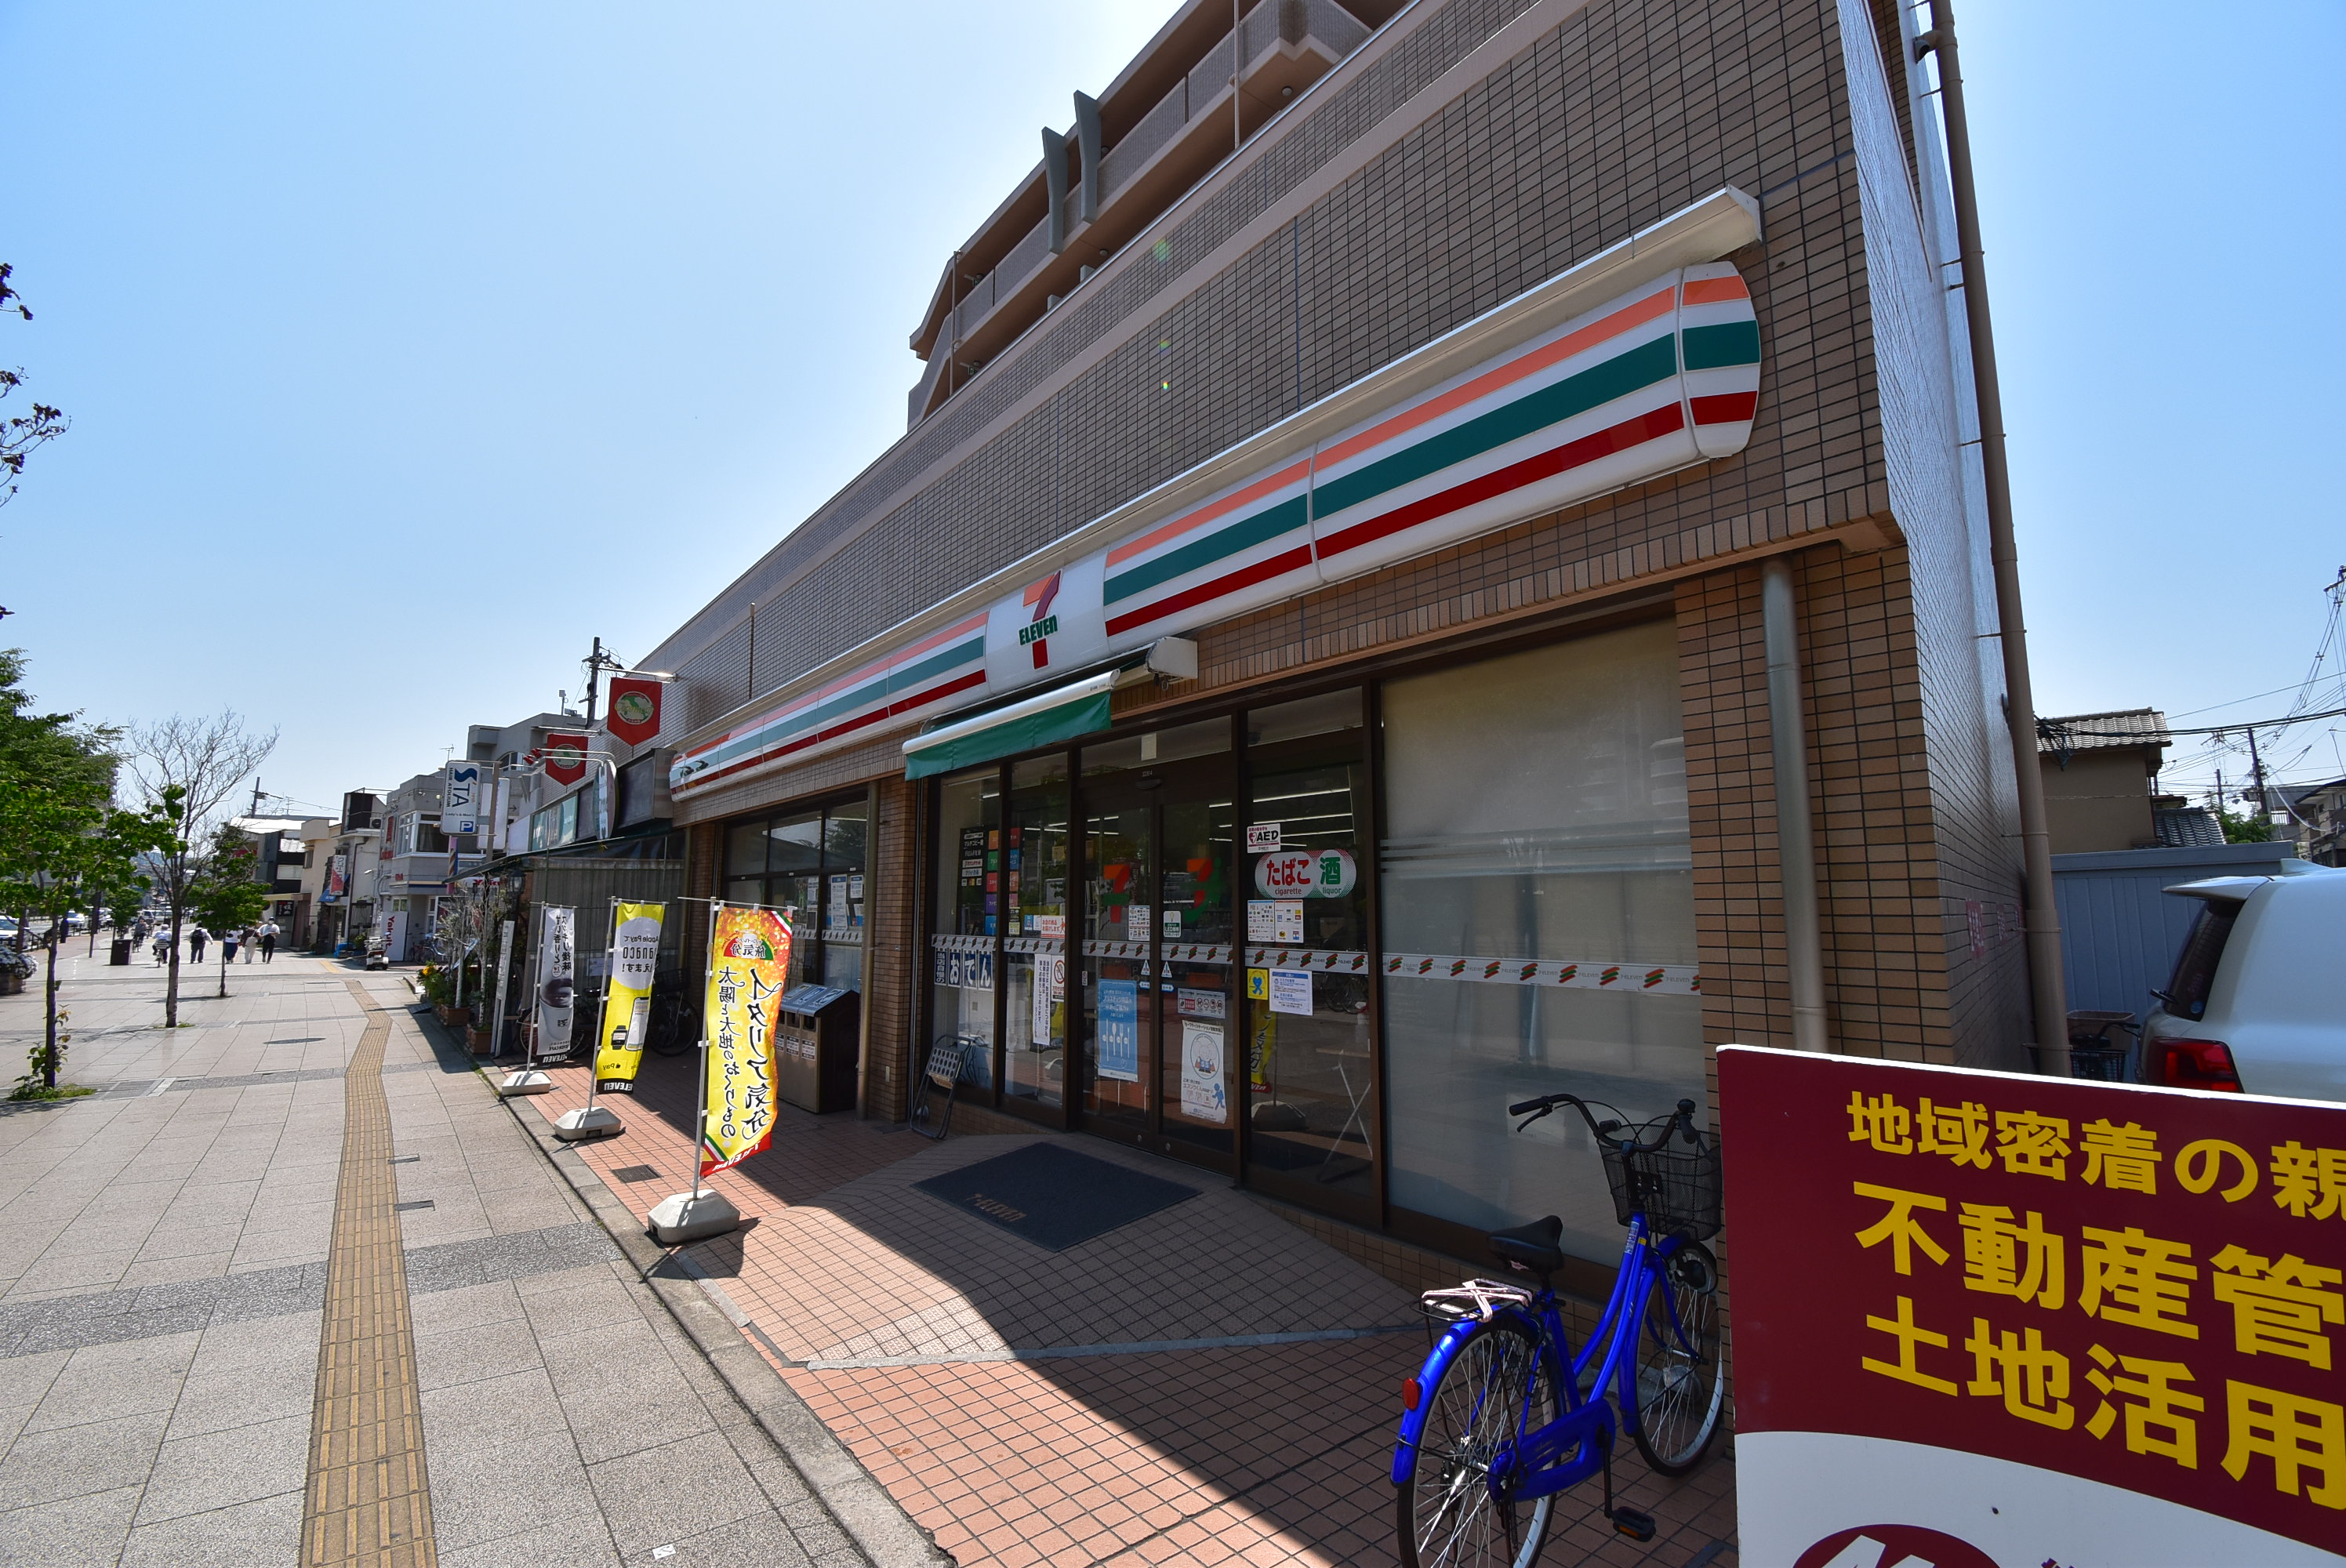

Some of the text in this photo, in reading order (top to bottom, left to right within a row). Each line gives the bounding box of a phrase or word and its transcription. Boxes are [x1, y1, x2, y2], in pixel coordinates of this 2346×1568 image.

[1256, 830, 1279, 841] AED
[1266, 857, 1310, 886] たばこ
[1320, 856, 1341, 885] 酒
[386, 916, 394, 948] Yakult
[950, 953, 991, 987] おでん
[1846, 1091, 2346, 1221] 地域密着の親
[1854, 1181, 2346, 1371] 不動産管
[1862, 1295, 2346, 1511] 土地活用
